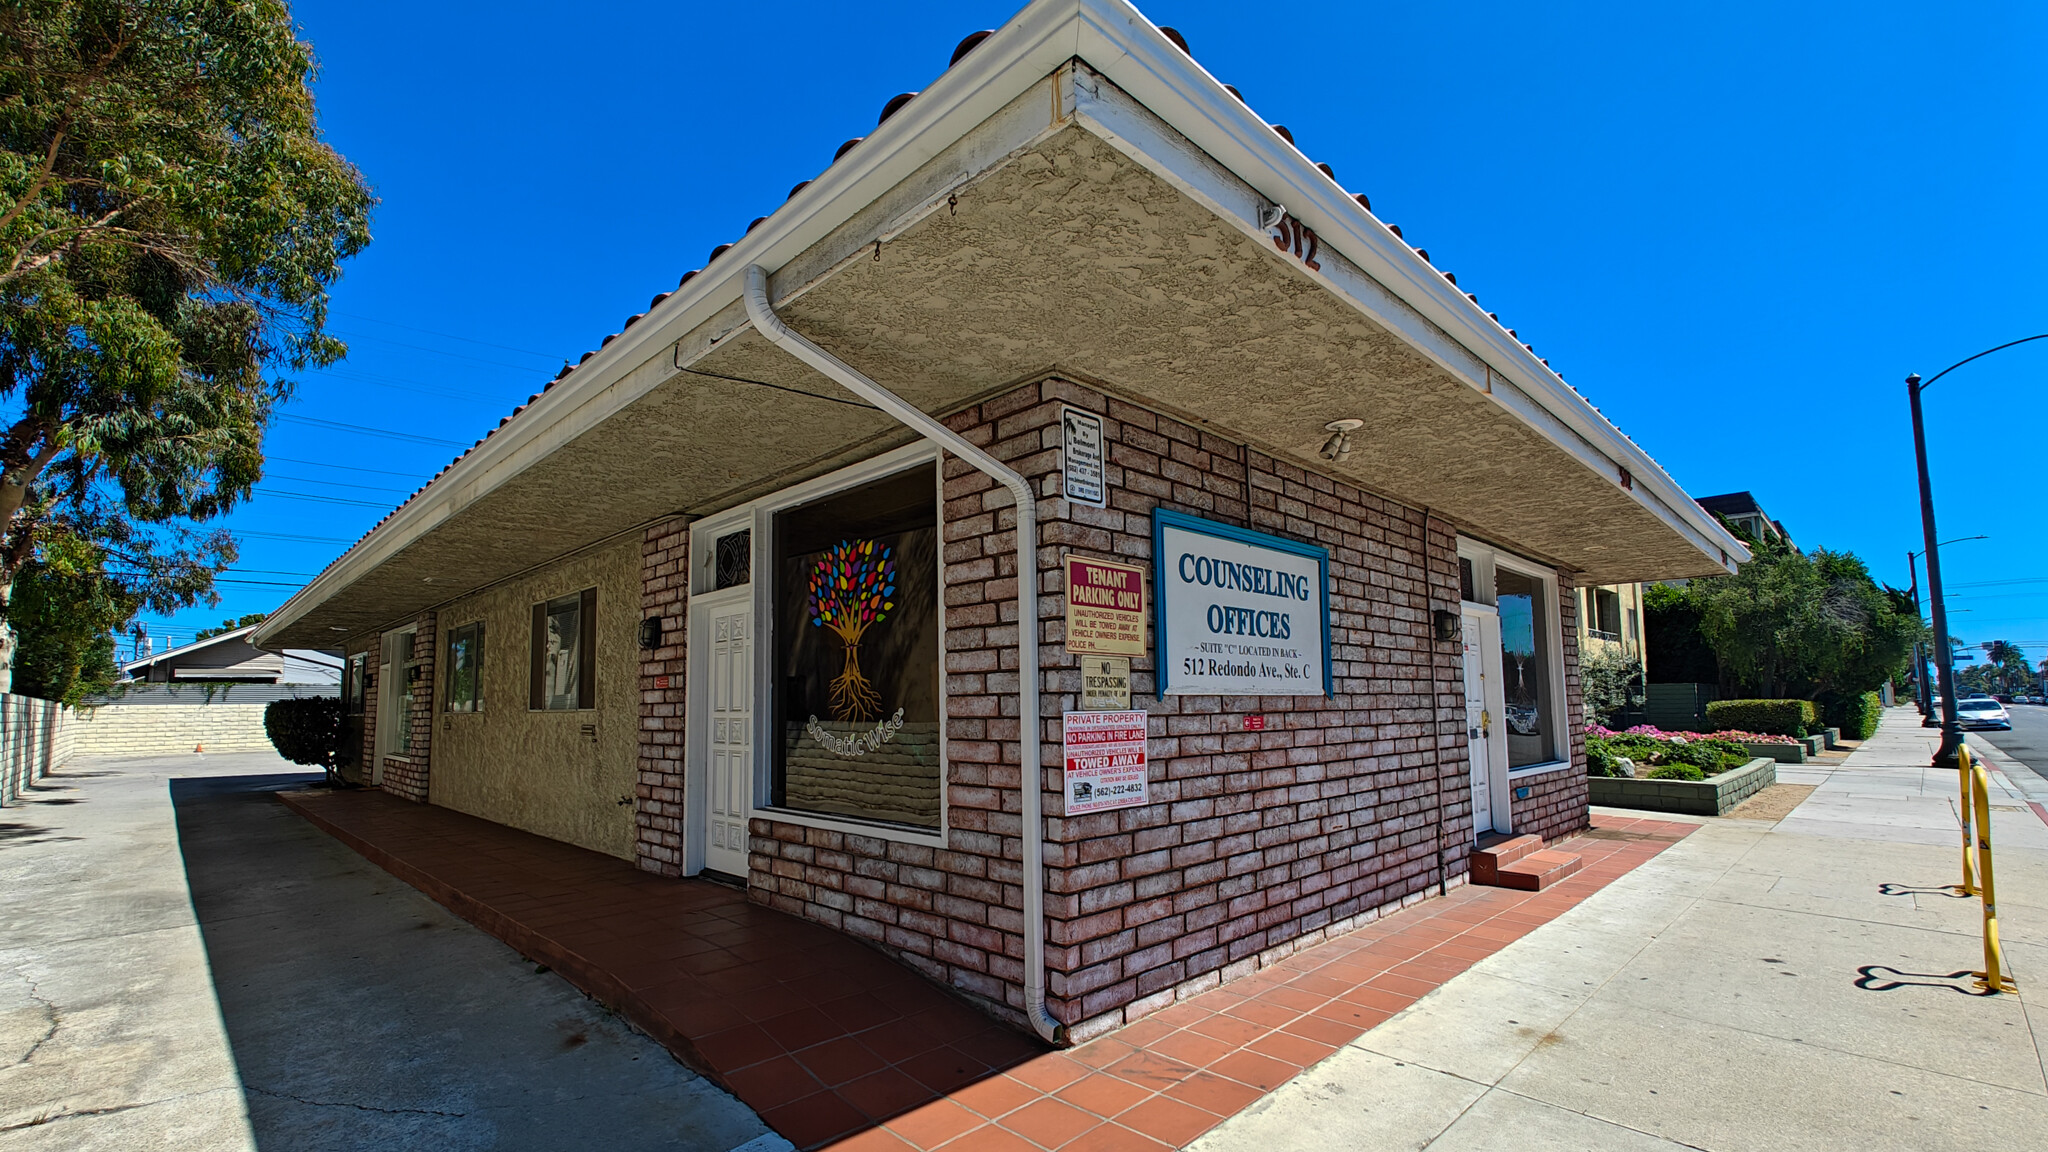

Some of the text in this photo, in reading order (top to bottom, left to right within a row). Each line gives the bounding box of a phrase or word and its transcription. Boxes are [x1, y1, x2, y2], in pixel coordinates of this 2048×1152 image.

[1273, 211, 1321, 272] 512
[1077, 420, 1098, 430] Managed
[1082, 431, 1089, 439] By
[1073, 437, 1096, 450] Belmont
[1072, 447, 1092, 460] Brokerage
[1067, 456, 1093, 468] Management
[1067, 465, 1078, 474] (562)
[1079, 467, 1087, 475] 437
[1086, 566, 1127, 589] TENANT
[1178, 552, 1309, 601] COUNSELING
[1072, 584, 1140, 610] PARKING ONLY
[1073, 608, 1139, 623] UNAUTHORIZED VEHICLES
[1206, 603, 1291, 640] OFFICES
[1075, 619, 1088, 628] WILL
[1098, 621, 1117, 631] TOWED
[1071, 628, 1094, 639] VEHICLE
[1094, 630, 1117, 640] OWNERS
[1068, 640, 1087, 650] POLICE
[1200, 642, 1223, 654] SUITE
[1224, 644, 1238, 655] "C"
[1238, 646, 1271, 656] LOCATED
[1272, 648, 1280, 658] IN
[1280, 648, 1298, 659] BACK
[1100, 661, 1111, 675] NO
[1183, 657, 1205, 676] 512
[1208, 658, 1257, 678] Redondo
[1284, 662, 1301, 679] Ste.
[1303, 663, 1311, 679] C
[1085, 675, 1127, 689] TRESPASSING
[1085, 690, 1097, 698] UNDER
[1098, 690, 1113, 698] PENALTY
[1119, 690, 1127, 698] LAW
[1067, 713, 1144, 725] PRIVATE PROPERTY
[806, 707, 905, 756] Somatic Wise
[1066, 729, 1144, 744] NO PARKING IN FIRE LANE
[1067, 750, 1106, 758] UNAUTHORIZED
[1106, 747, 1128, 755] VEHICLES
[1127, 746, 1138, 754] WILL
[1074, 753, 1139, 770] TOWED AWAY
[1066, 765, 1145, 778] AT VEHICLE OWNER'S EXPENSE
[1127, 773, 1139, 781] ISSUED
[1094, 783, 1142, 798] (562)-222-4832
